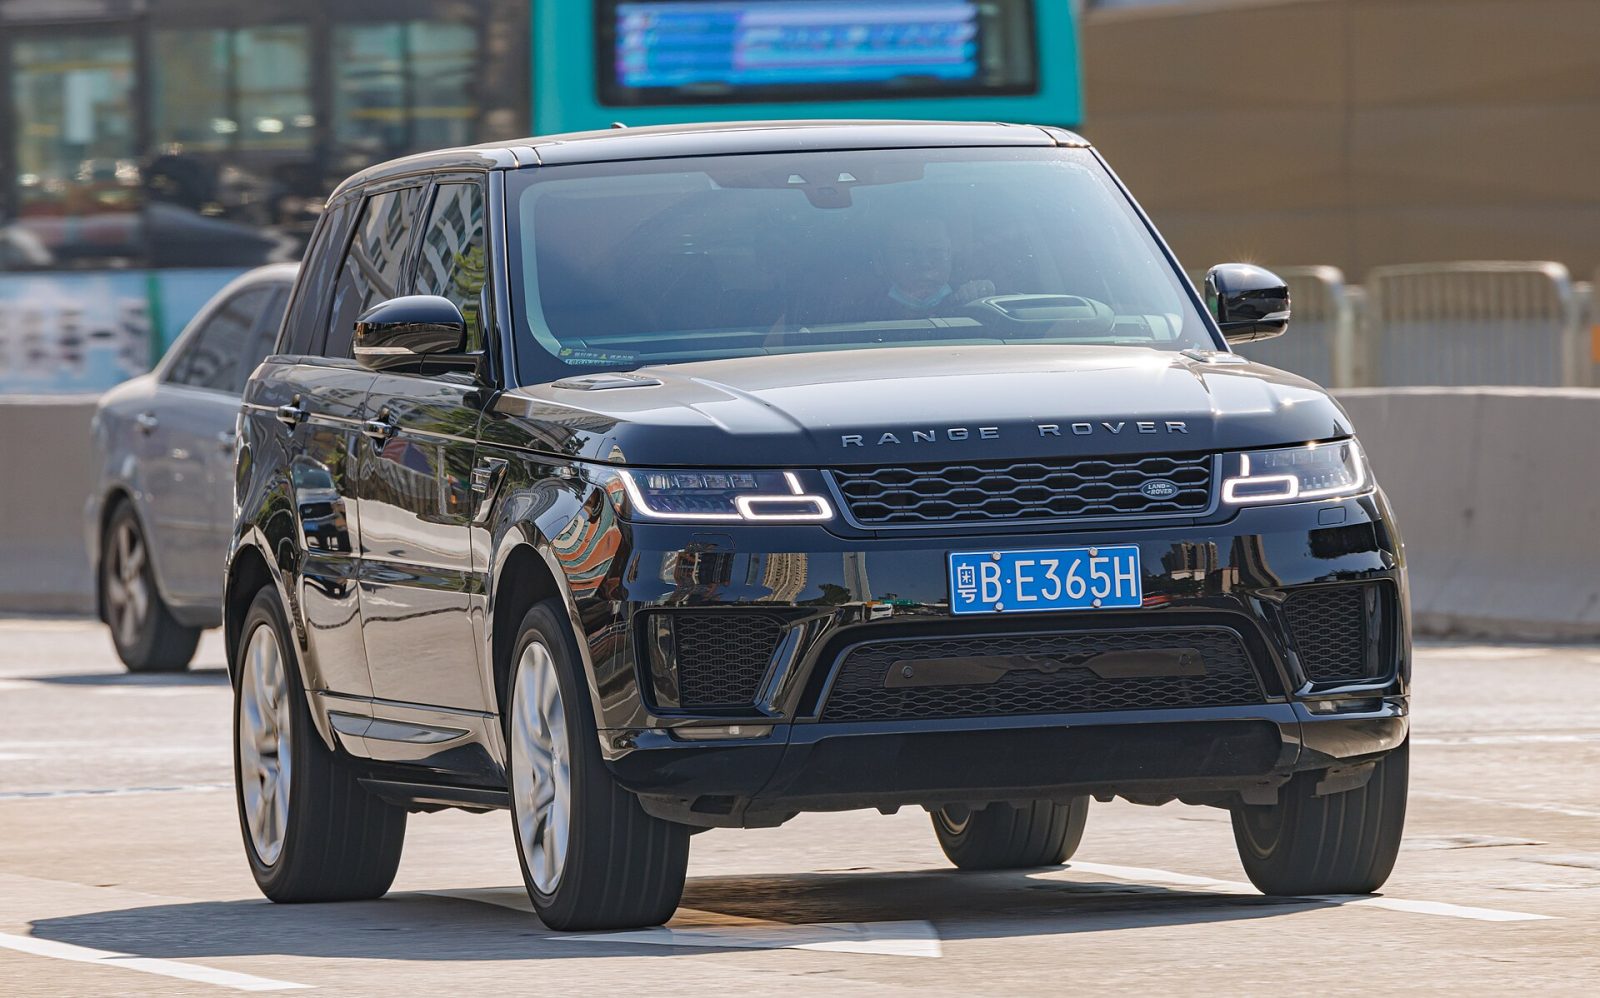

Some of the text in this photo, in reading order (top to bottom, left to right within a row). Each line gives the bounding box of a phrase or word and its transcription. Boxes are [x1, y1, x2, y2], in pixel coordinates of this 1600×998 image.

[841, 421, 1190, 448] RANGE ROVER
[957, 556, 1137, 604] 粤B·E365H
